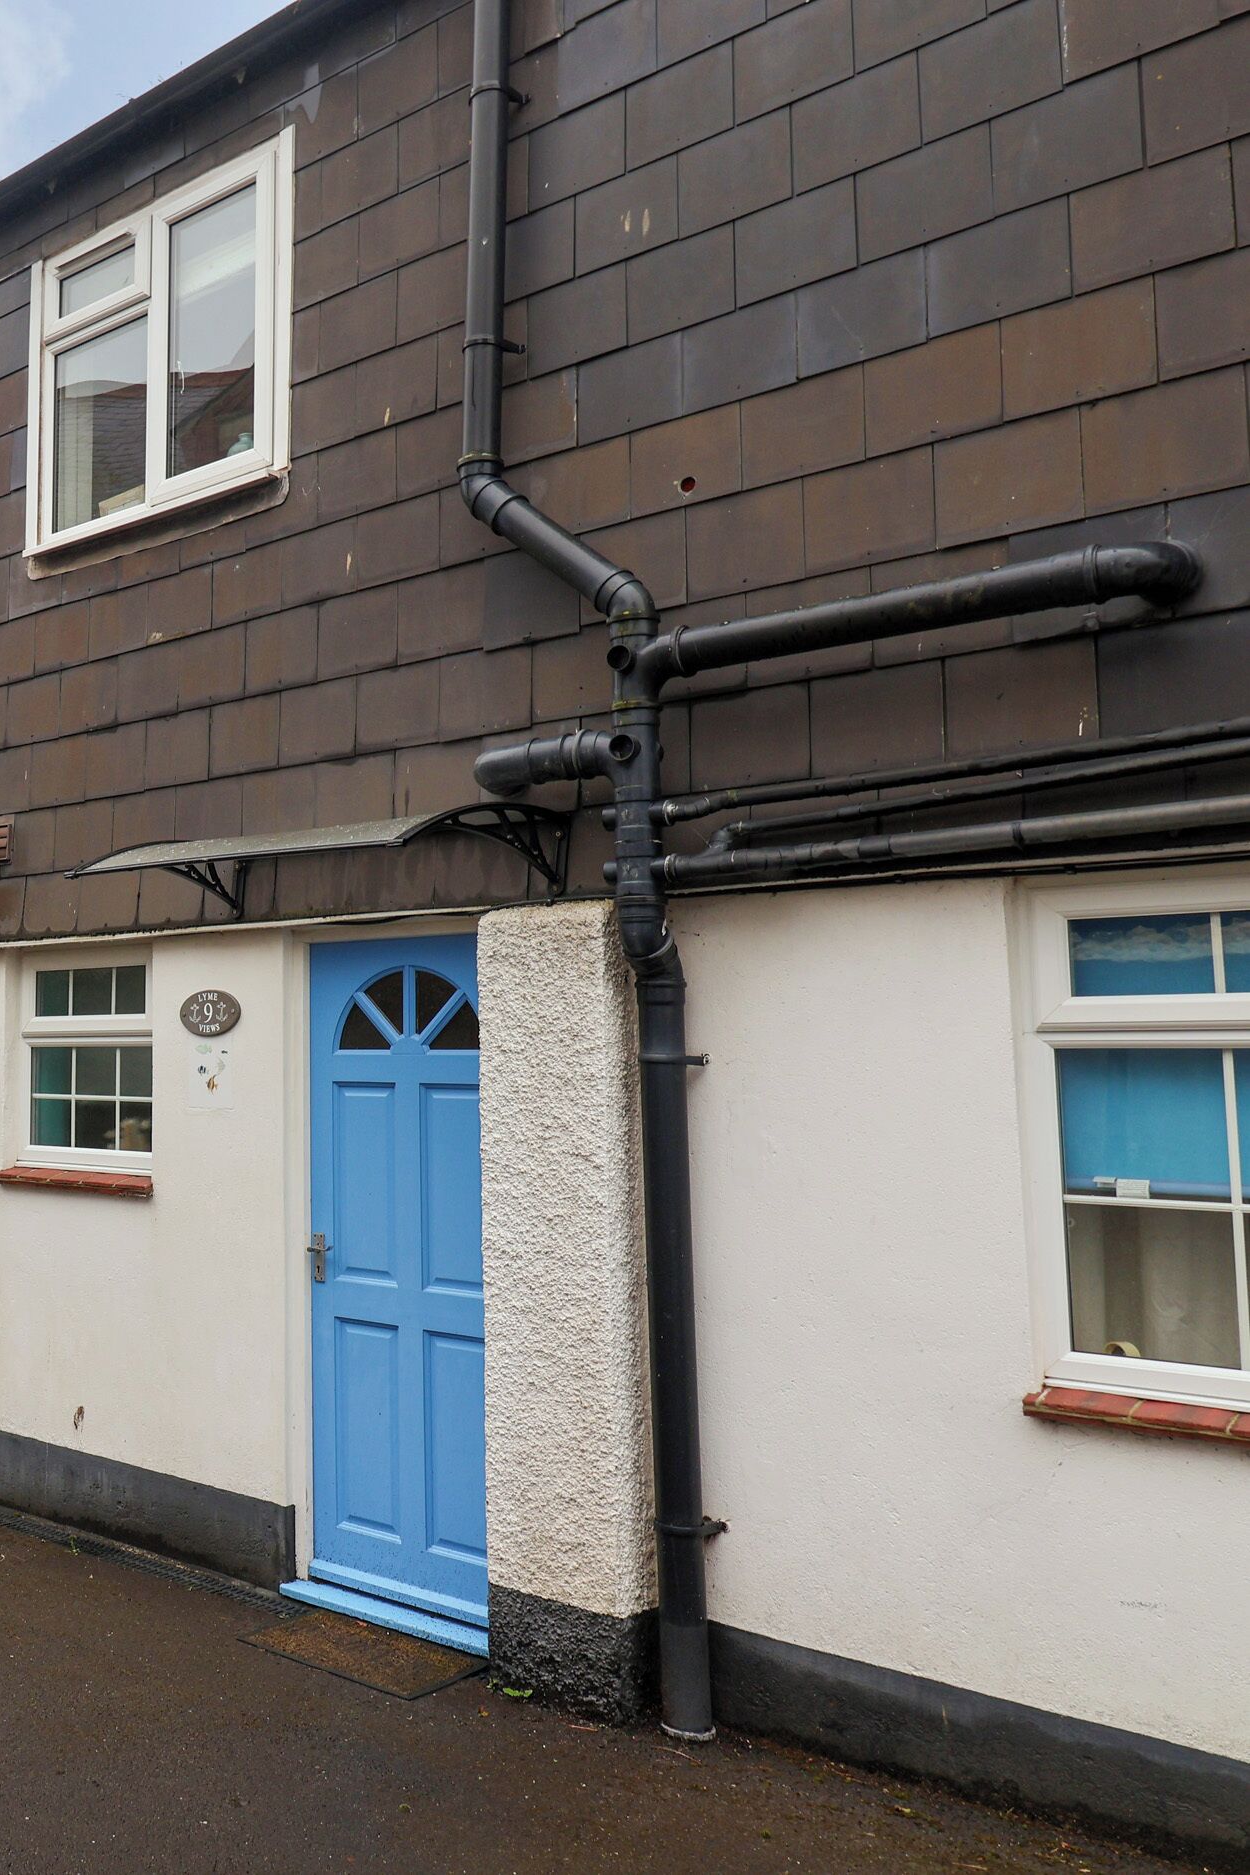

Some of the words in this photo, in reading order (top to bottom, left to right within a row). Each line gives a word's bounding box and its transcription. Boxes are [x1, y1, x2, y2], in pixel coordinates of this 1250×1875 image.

[198, 992, 218, 1002] LYME
[203, 1002, 213, 1023] 9
[198, 1023, 220, 1033] VIEWS
